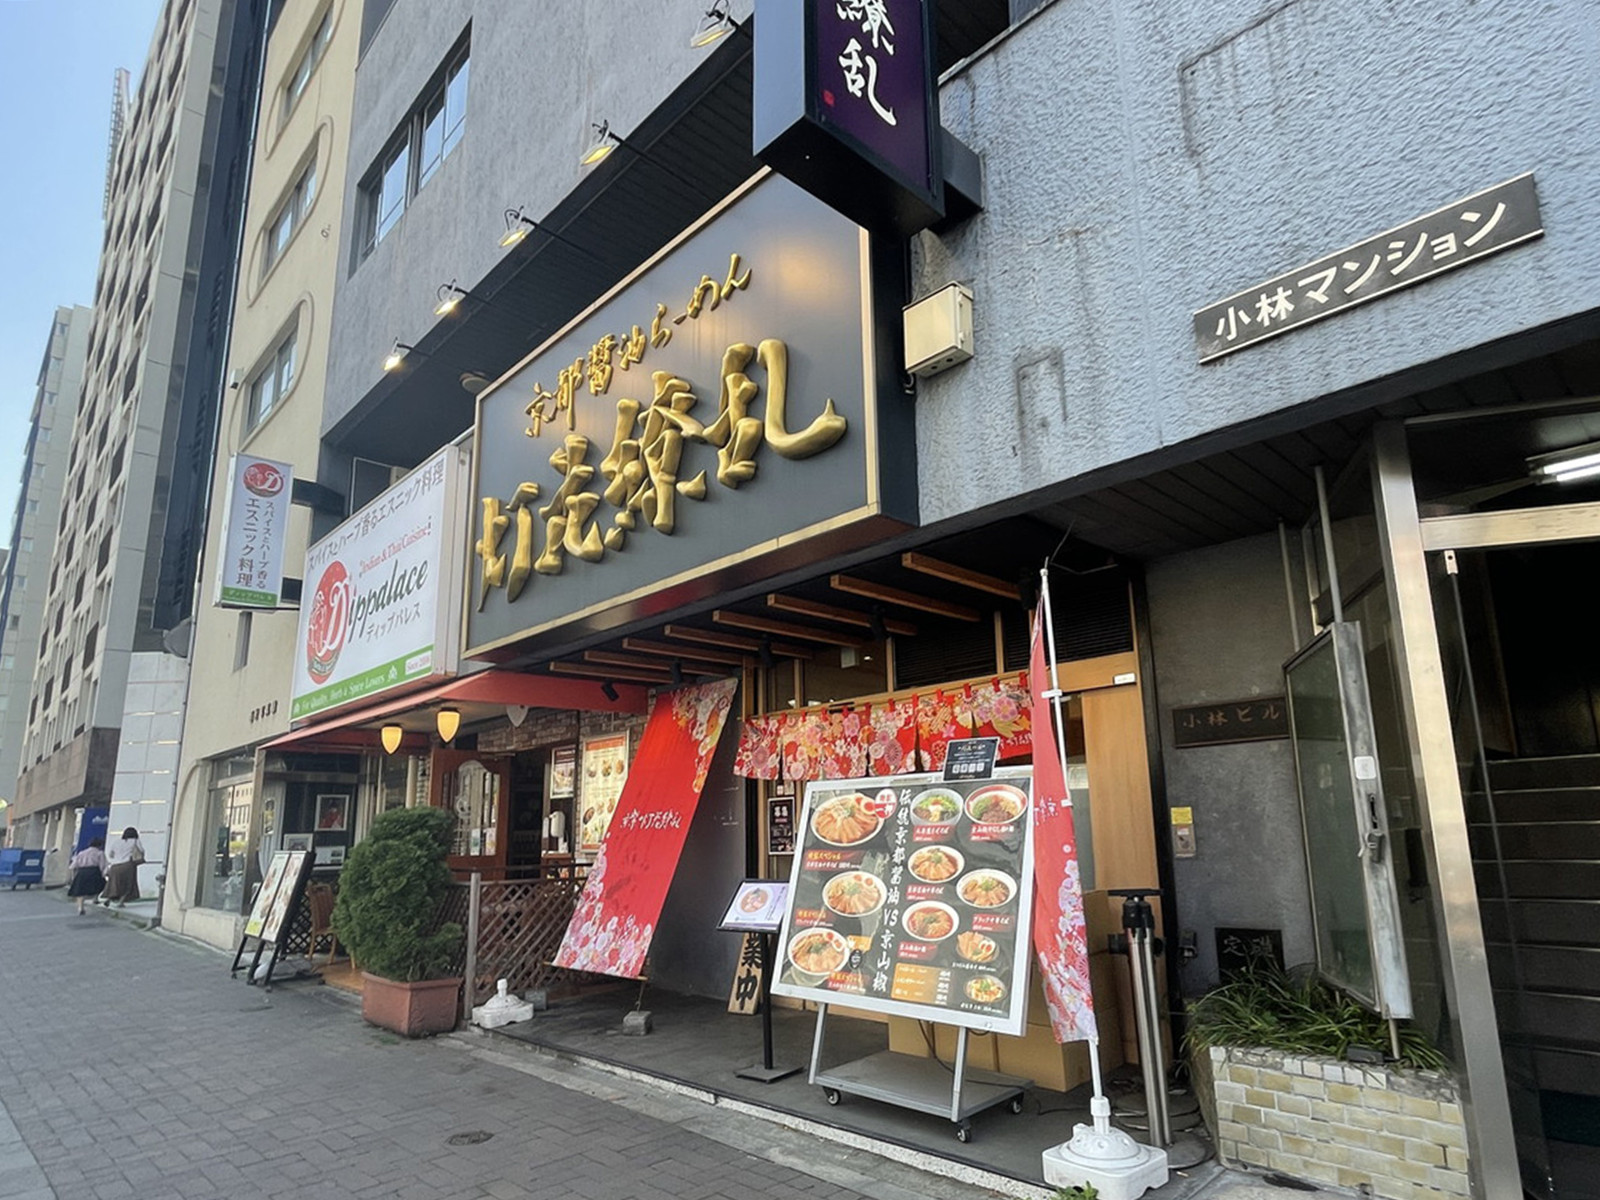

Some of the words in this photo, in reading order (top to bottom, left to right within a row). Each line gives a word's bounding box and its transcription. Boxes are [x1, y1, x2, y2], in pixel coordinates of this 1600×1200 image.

[1215, 202, 1506, 341] 小林マンション
[236, 498, 261, 588] エスニック料理
[1183, 704, 1280, 728] 小林ビル
